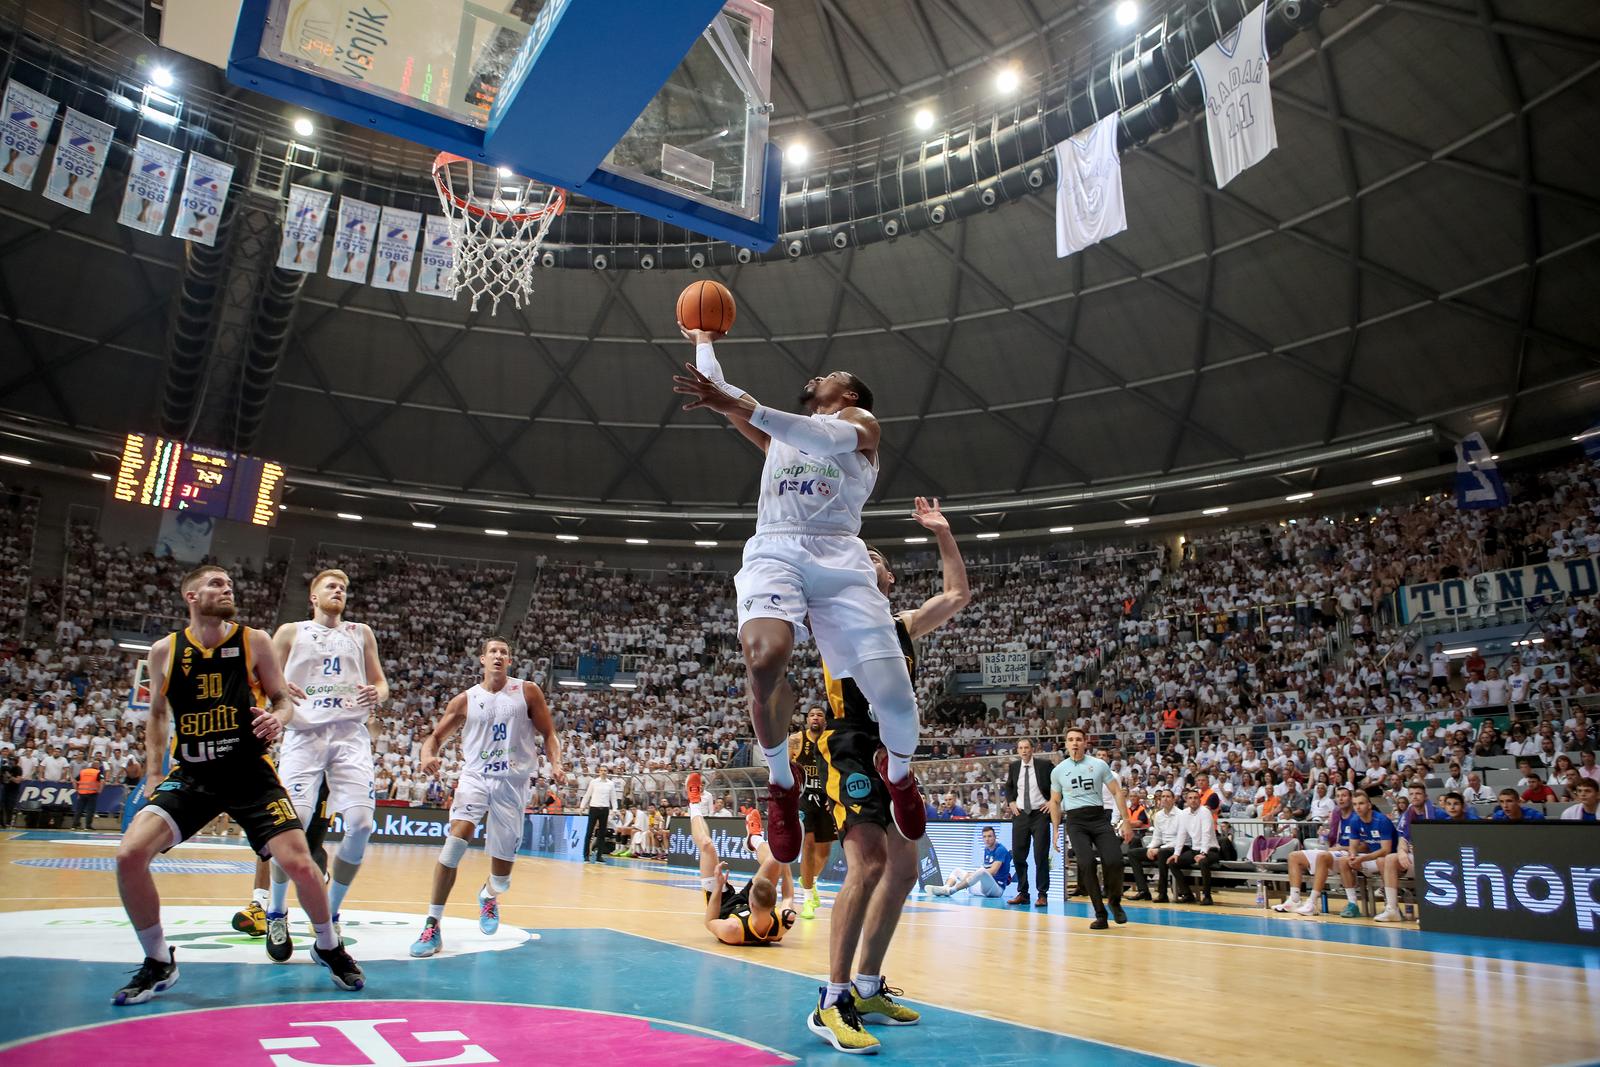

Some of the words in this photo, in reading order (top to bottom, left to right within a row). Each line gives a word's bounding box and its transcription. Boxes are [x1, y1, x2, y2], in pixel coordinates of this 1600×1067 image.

[1207, 58, 1264, 116] ZADAR
[1226, 93, 1254, 139] 11
[779, 479, 816, 496] PSK
[323, 656, 342, 675] 24
[1007, 654, 1026, 662] rana
[196, 672, 222, 700] 30
[313, 697, 343, 709] PSK
[180, 705, 239, 736] split
[492, 722, 507, 742] 29
[484, 760, 509, 774] PSK
[18, 786, 77, 806] PSK
[266, 798, 297, 826] 30
